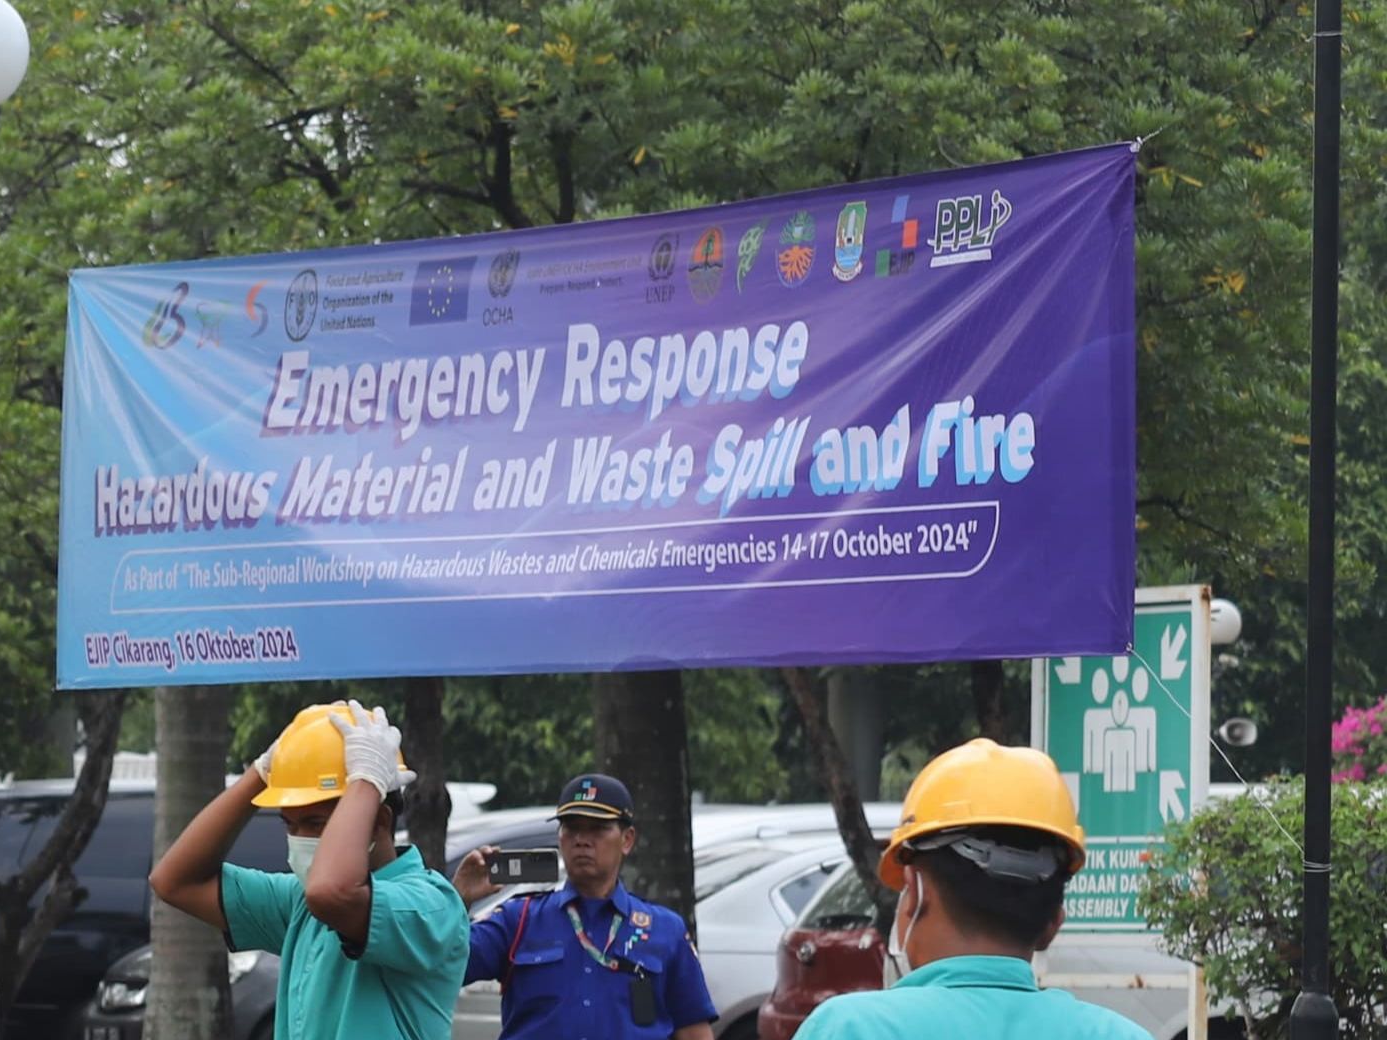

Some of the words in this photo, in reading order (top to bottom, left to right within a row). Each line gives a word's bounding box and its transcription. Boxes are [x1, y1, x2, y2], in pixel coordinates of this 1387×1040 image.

[323, 294, 369, 312] Organization
[370, 291, 381, 304] of
[381, 290, 393, 303] the
[646, 285, 675, 303] UNEP
[321, 317, 345, 331] United
[346, 315, 375, 328] Nations
[483, 307, 513, 326] OCHA
[266, 348, 546, 441] Emergency
[561, 321, 809, 421] Response
[96, 455, 277, 532] Hazardous
[281, 445, 469, 518] Material
[473, 438, 557, 511] and
[566, 429, 695, 505] Waste
[701, 415, 811, 510] Spill
[812, 403, 911, 488] and
[924, 395, 1035, 480] Fire
[125, 565, 138, 591] As
[140, 565, 163, 591] Part
[165, 562, 179, 590] of
[213, 557, 300, 593] Sub-Regional
[302, 553, 374, 588] Workshop
[378, 559, 397, 580] on
[399, 550, 486, 579] Hazardous
[488, 548, 543, 576] Wastes
[545, 545, 579, 574] and
[580, 540, 658, 571] Chemicals
[661, 534, 776, 573] Emergencies
[781, 529, 829, 561] 14-17
[833, 523, 913, 559] October
[86, 636, 109, 665] EJIP
[112, 631, 176, 670] Cikarang,
[176, 633, 196, 662] 16
[196, 628, 255, 661] Oktober
[257, 629, 297, 659] 2024
